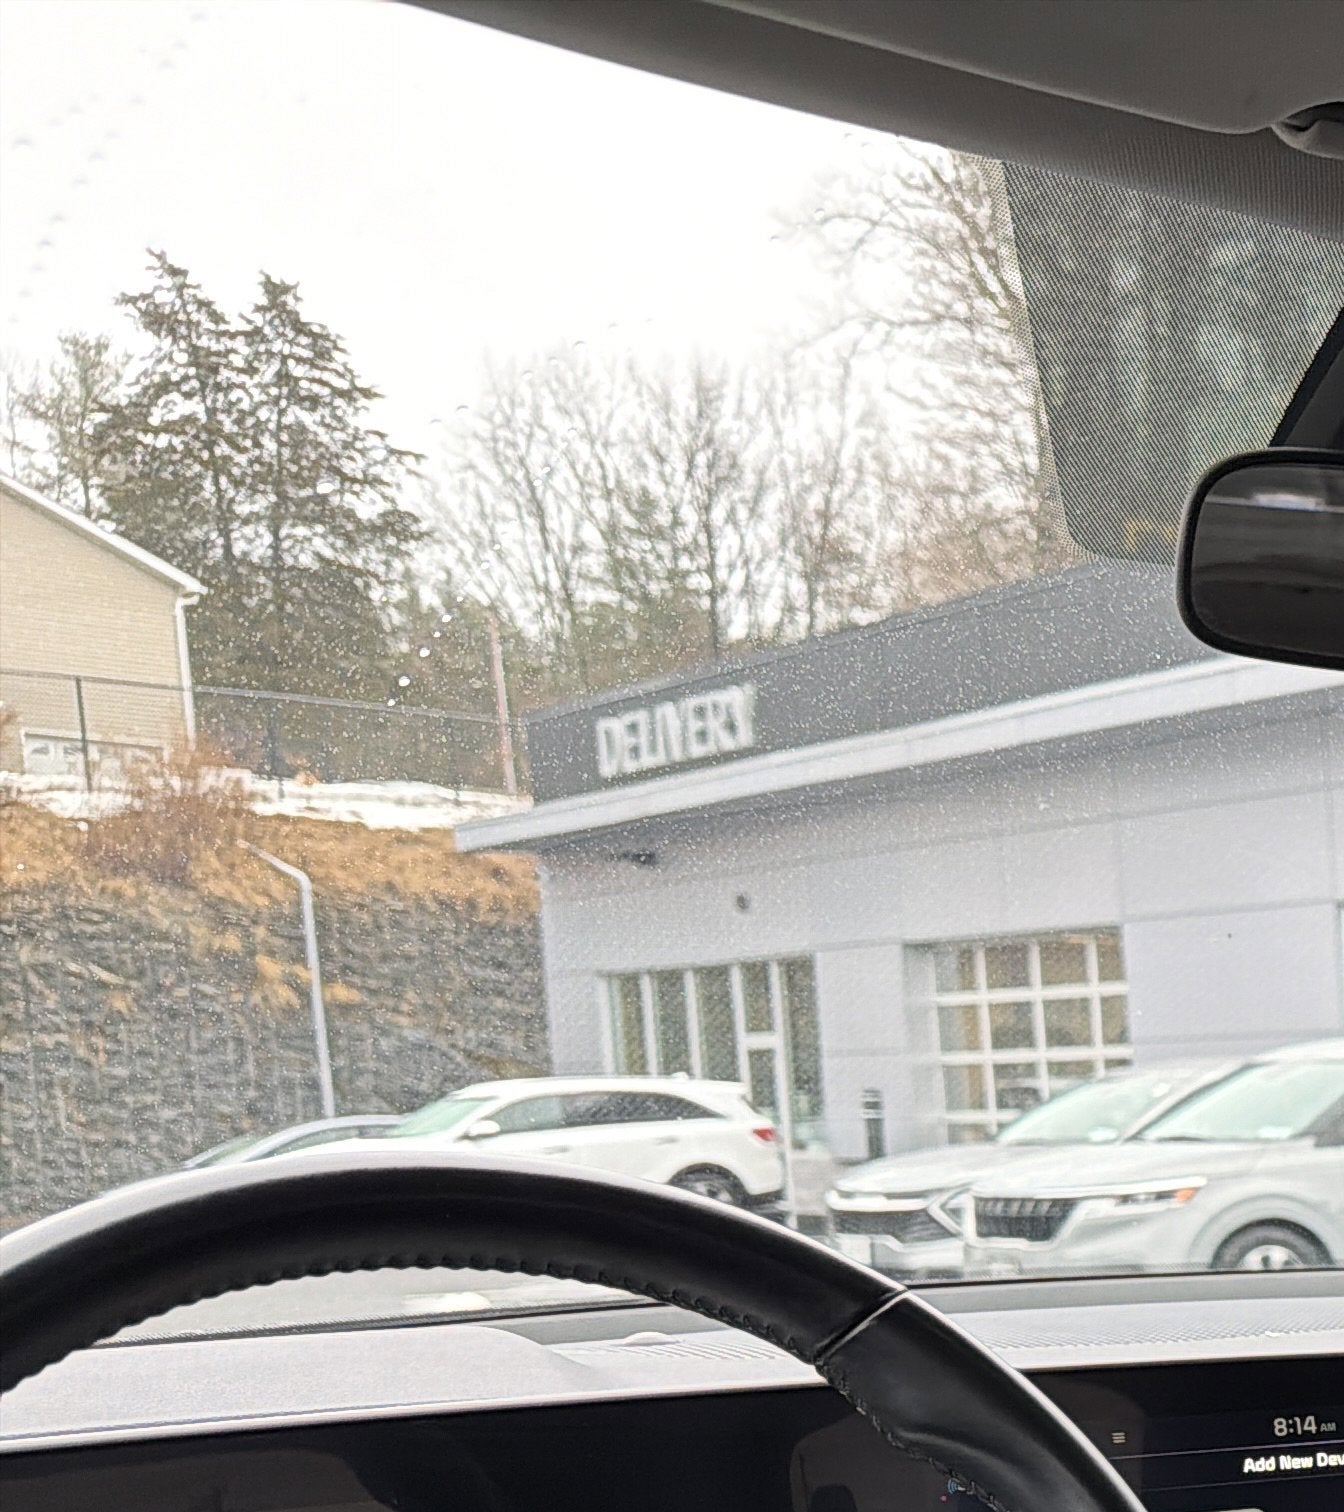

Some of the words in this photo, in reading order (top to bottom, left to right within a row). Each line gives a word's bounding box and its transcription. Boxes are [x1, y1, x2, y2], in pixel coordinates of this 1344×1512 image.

[597, 686, 755, 778] DELIVERY
[1273, 1415, 1318, 1437] 8:14
[1320, 1423, 1337, 1432] AM
[1243, 1457, 1275, 1473] Add
[1279, 1454, 1313, 1470] New
